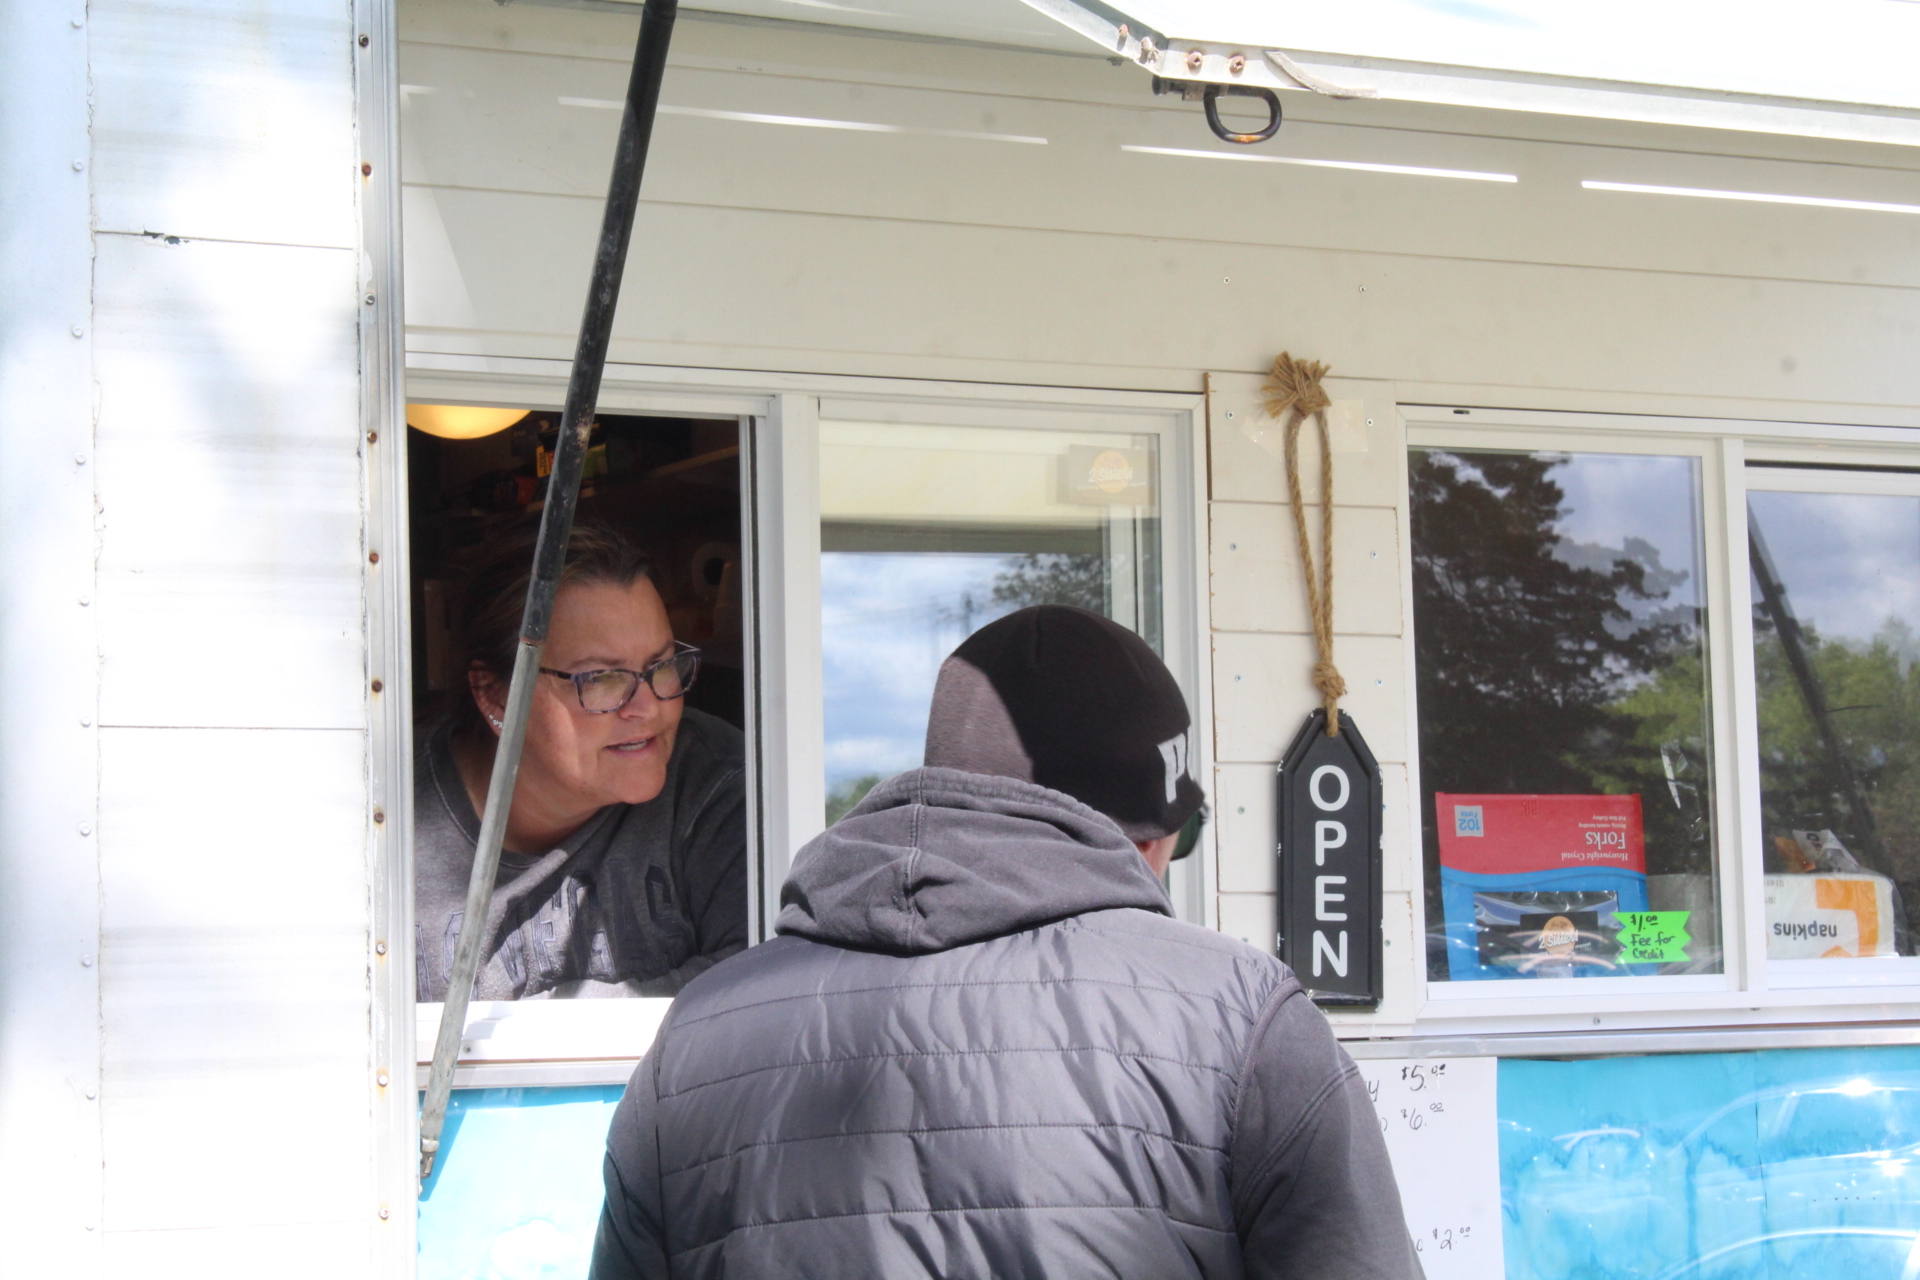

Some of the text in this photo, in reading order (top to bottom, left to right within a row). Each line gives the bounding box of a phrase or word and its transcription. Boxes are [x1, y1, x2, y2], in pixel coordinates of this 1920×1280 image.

[1459, 818, 1480, 831] 102
[1585, 832, 1626, 850] Forks
[1561, 851, 1585, 861] Crystal
[1309, 764, 1350, 979] OPEN
[1773, 920, 1837, 940] napkins
[1630, 931, 1676, 947] Fee for
[1632, 947, 1665, 960] Credit
